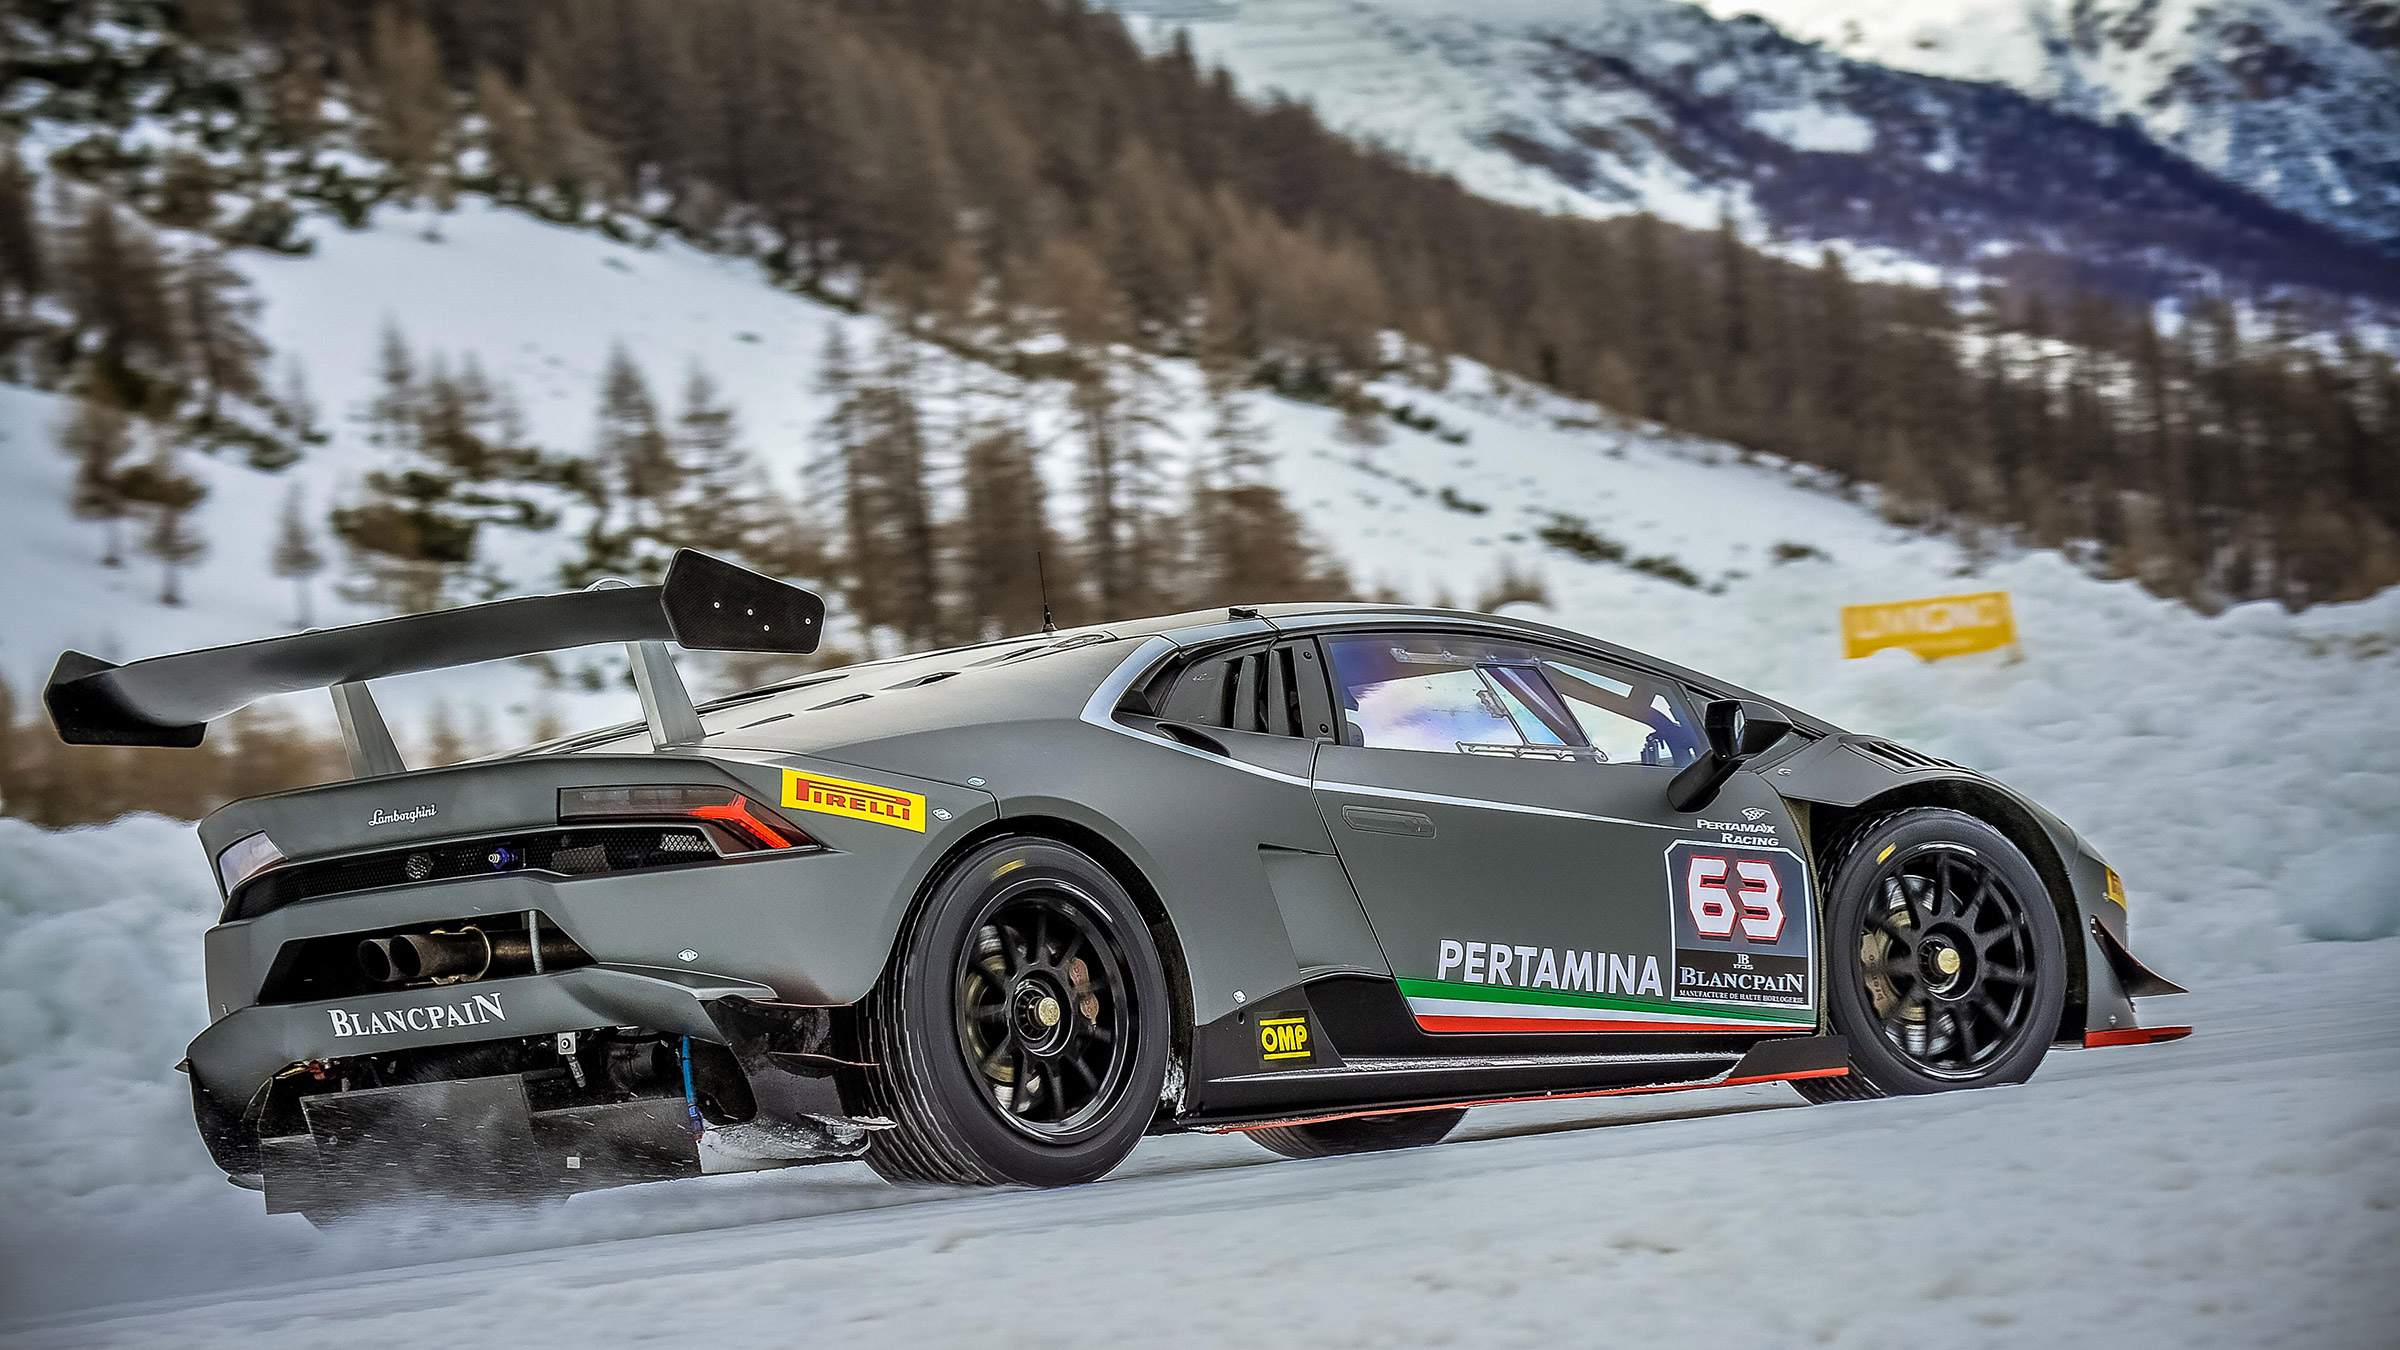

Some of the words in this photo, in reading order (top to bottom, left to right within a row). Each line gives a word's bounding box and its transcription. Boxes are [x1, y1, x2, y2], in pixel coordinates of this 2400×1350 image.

[796, 777, 911, 821] PIRELLI
[368, 804, 438, 826] Lamborghini
[1696, 819, 1776, 834] PERTAMAX
[1721, 832, 1780, 846] RACING
[1687, 855, 1786, 945] 63
[1437, 939, 1664, 997] PERTAMINA
[1679, 966, 1805, 993] BLANCPAIN
[1679, 989, 1728, 999] MANUFACTURE
[1729, 992, 1739, 1000] DE
[1762, 995, 1804, 1004] HORLOGERIE
[327, 992, 506, 1037] BLANCPAIN
[1261, 1024, 1308, 1052] OMP
